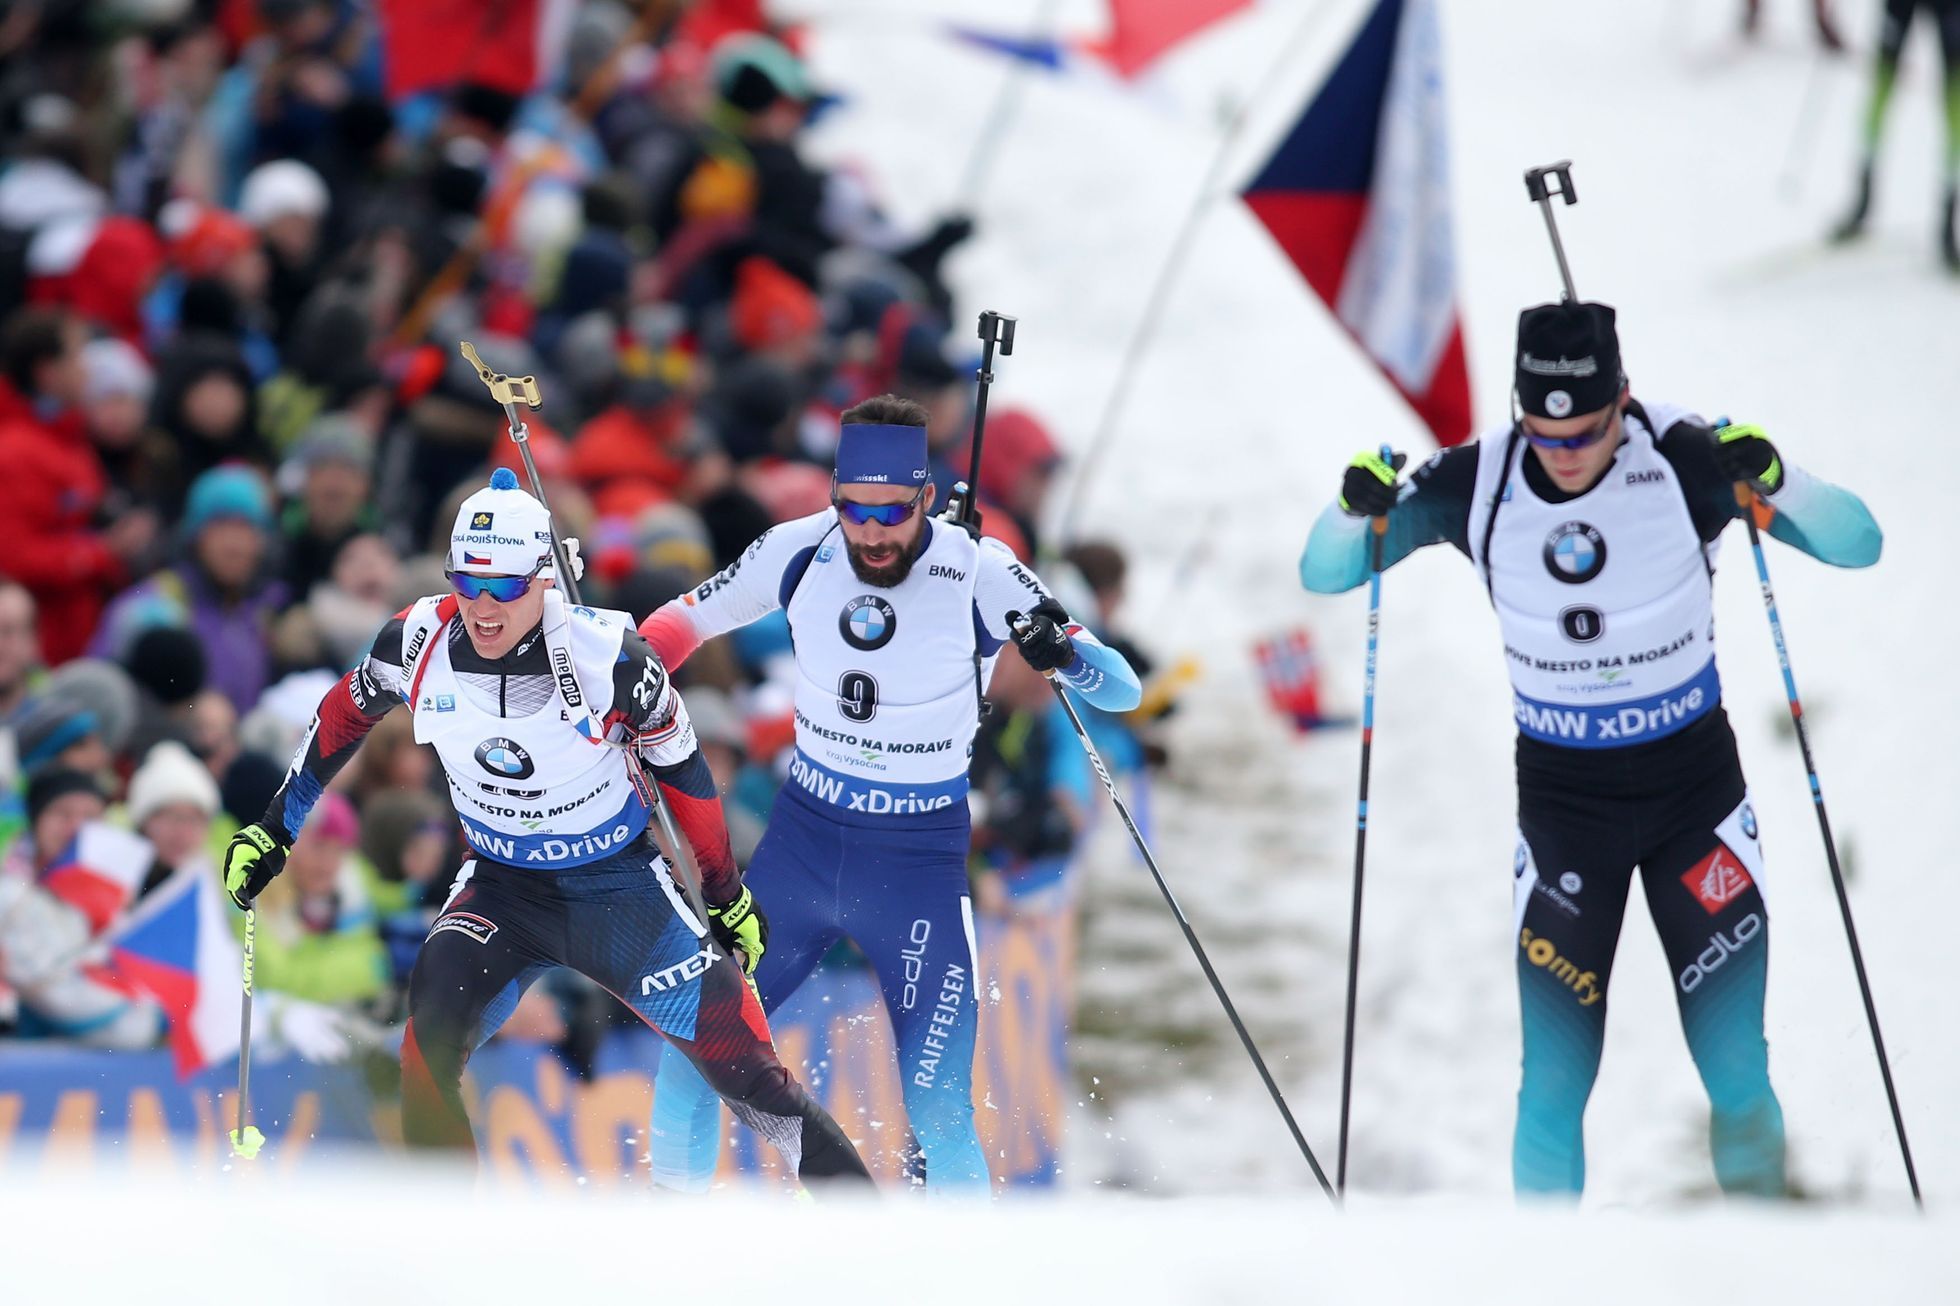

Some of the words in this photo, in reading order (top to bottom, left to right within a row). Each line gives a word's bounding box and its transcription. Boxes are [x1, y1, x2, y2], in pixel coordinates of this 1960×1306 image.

[1626, 470, 1665, 485] BMW
[466, 533, 525, 546] POJIŠŤOVNA
[928, 564, 966, 582] BMW
[848, 596, 894, 617] BMW
[1535, 659, 1592, 672] MESTO
[1597, 656, 1623, 669] NA
[1629, 628, 1695, 665] MORAVE
[554, 649, 581, 706] meopta
[633, 655, 662, 704] 211
[837, 669, 880, 724] 9
[1597, 686, 1705, 741] xDrive
[481, 738, 529, 761] BMW
[811, 724, 858, 746] MESTO
[861, 737, 883, 752] NA
[886, 737, 953, 755] MORAVE
[473, 799, 516, 818] ESTO
[520, 810, 545, 819] NA
[548, 779, 612, 818] MORAVE
[847, 788, 953, 814] xDrive
[526, 824, 630, 862] xDrive
[641, 943, 722, 996] ATEX
[901, 919, 932, 1010] odlo
[1679, 912, 1761, 994] odlo
[914, 963, 965, 1089] RAIFFEISEN
